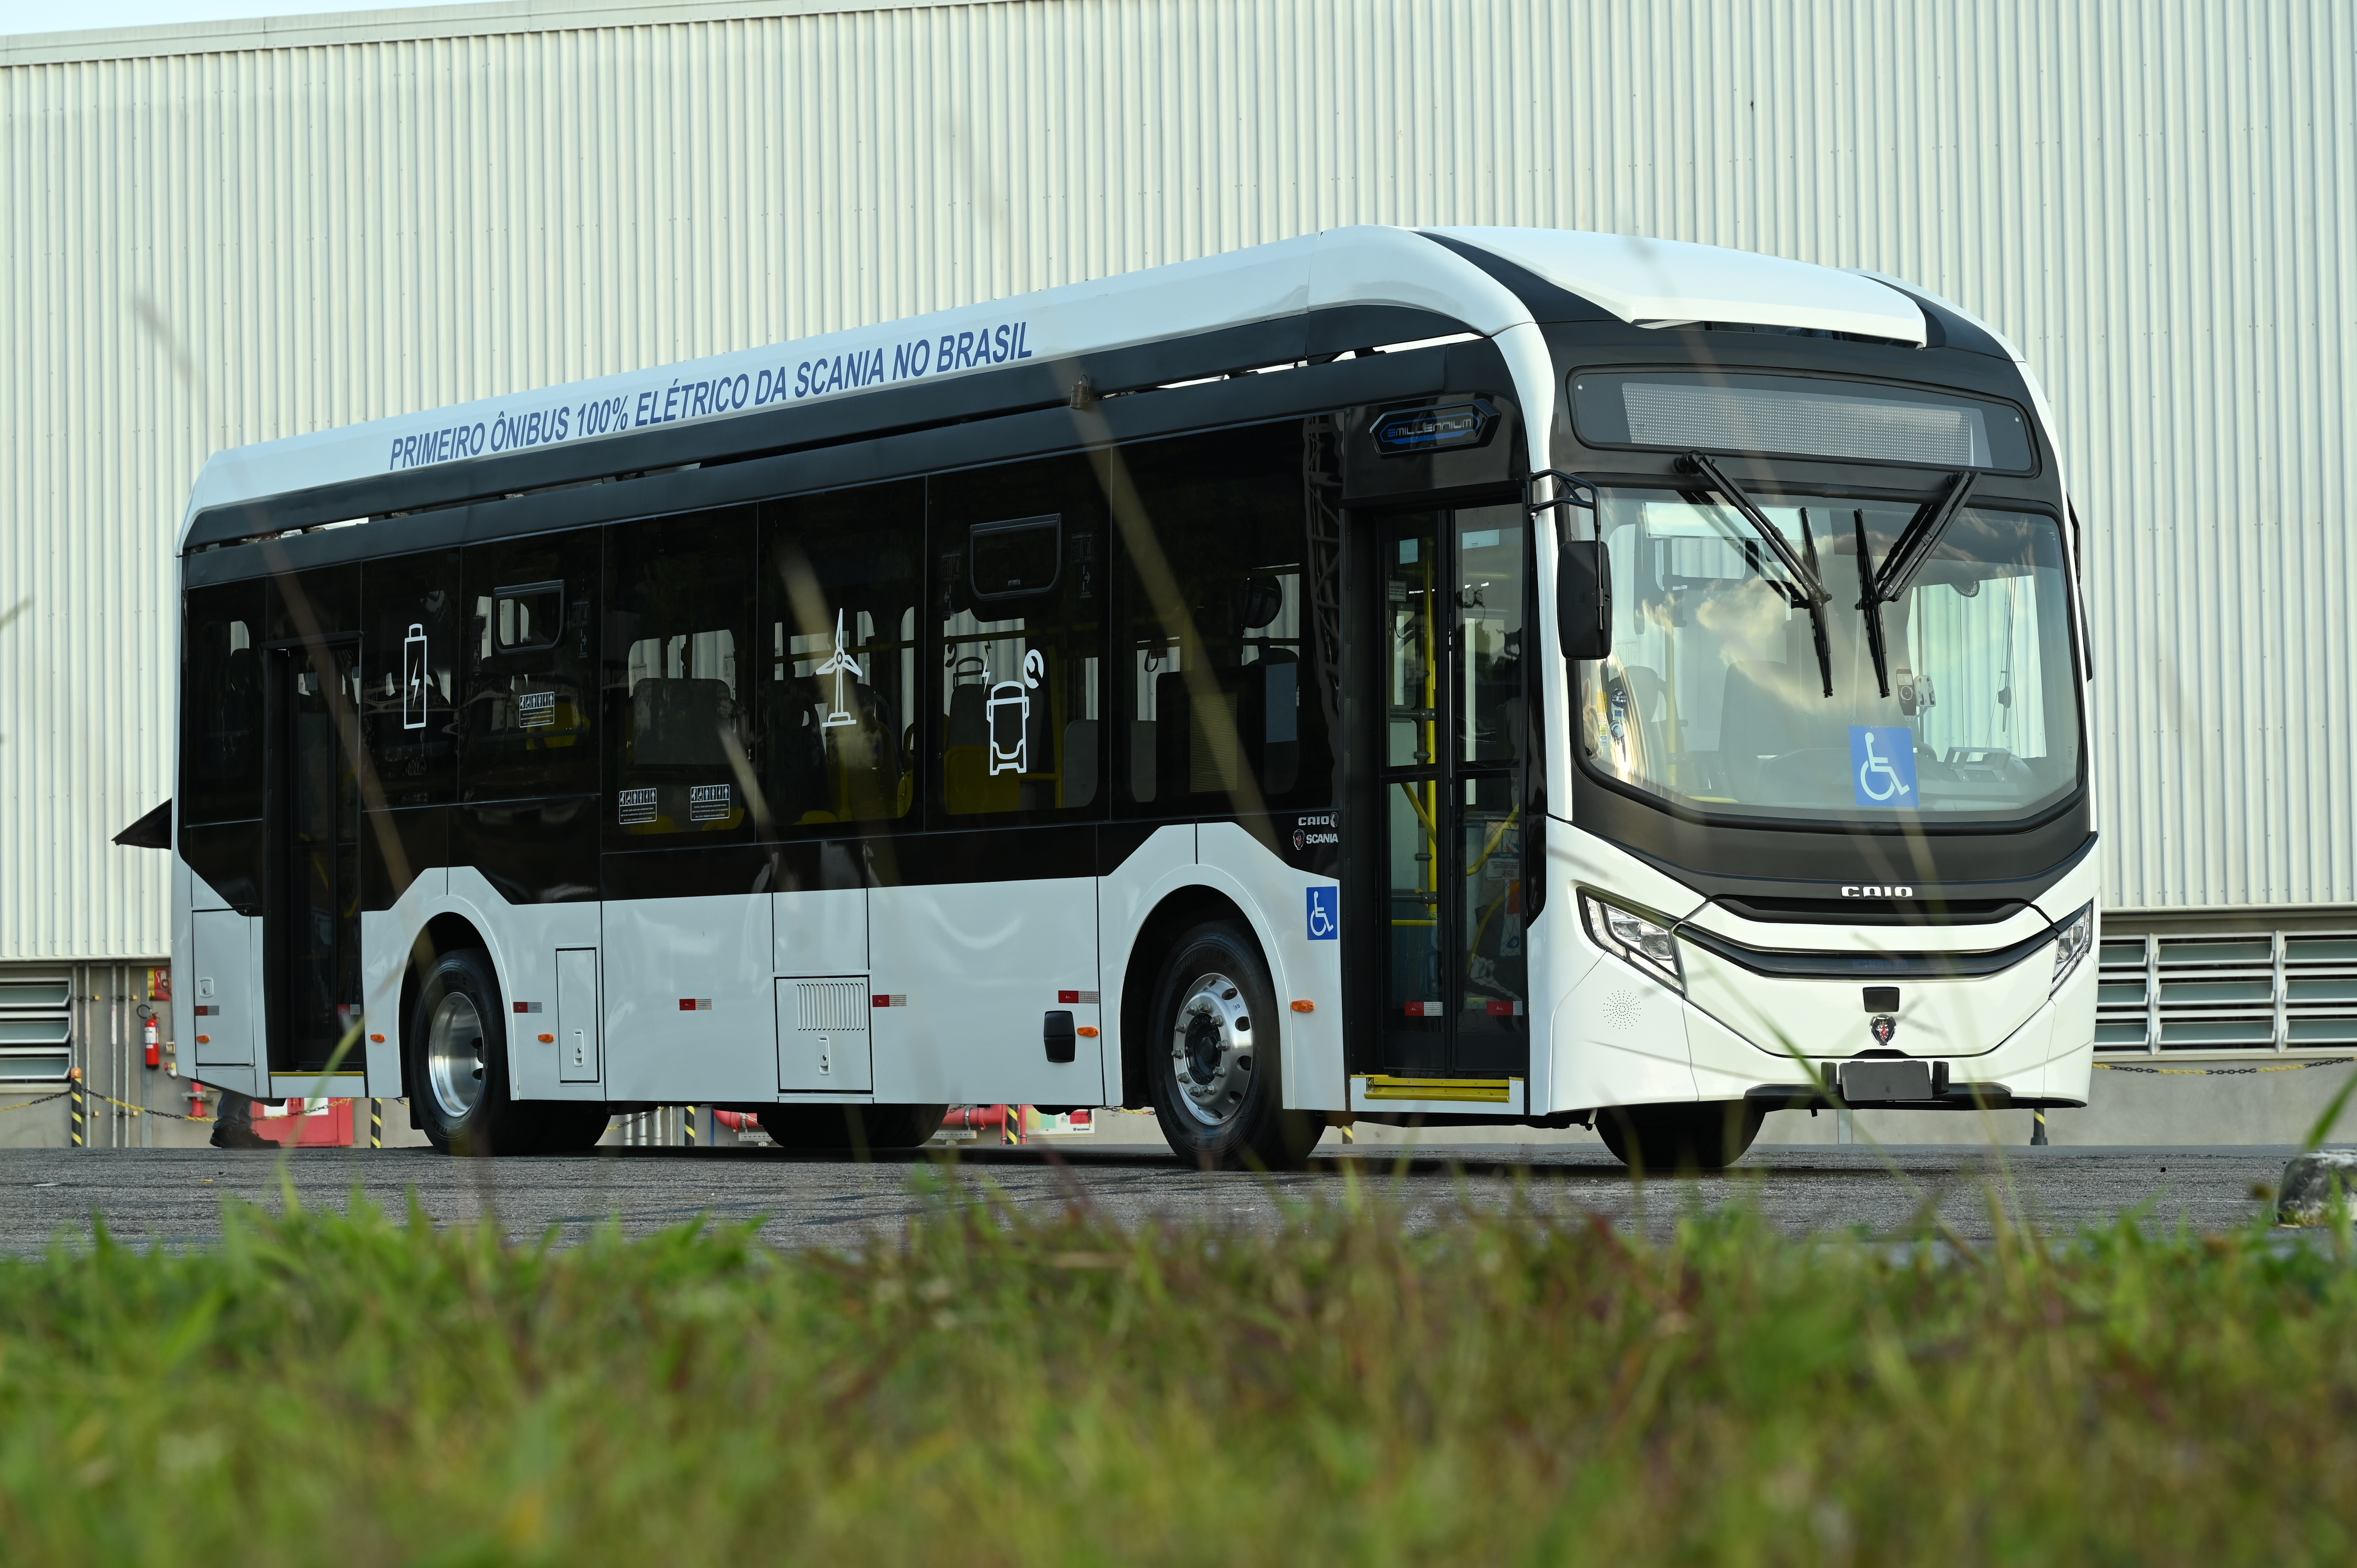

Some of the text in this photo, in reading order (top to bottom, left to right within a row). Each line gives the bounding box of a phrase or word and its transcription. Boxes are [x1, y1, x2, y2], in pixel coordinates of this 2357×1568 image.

[390, 321, 1032, 470] PRIMEIRO ÔNIBUS 100% ELÉTRICO DA SCANIA NO BRASIL
[1298, 816, 1330, 826] CAIO
[1306, 833, 1339, 844] SCANIA
[1841, 886, 1913, 899] CAIO
